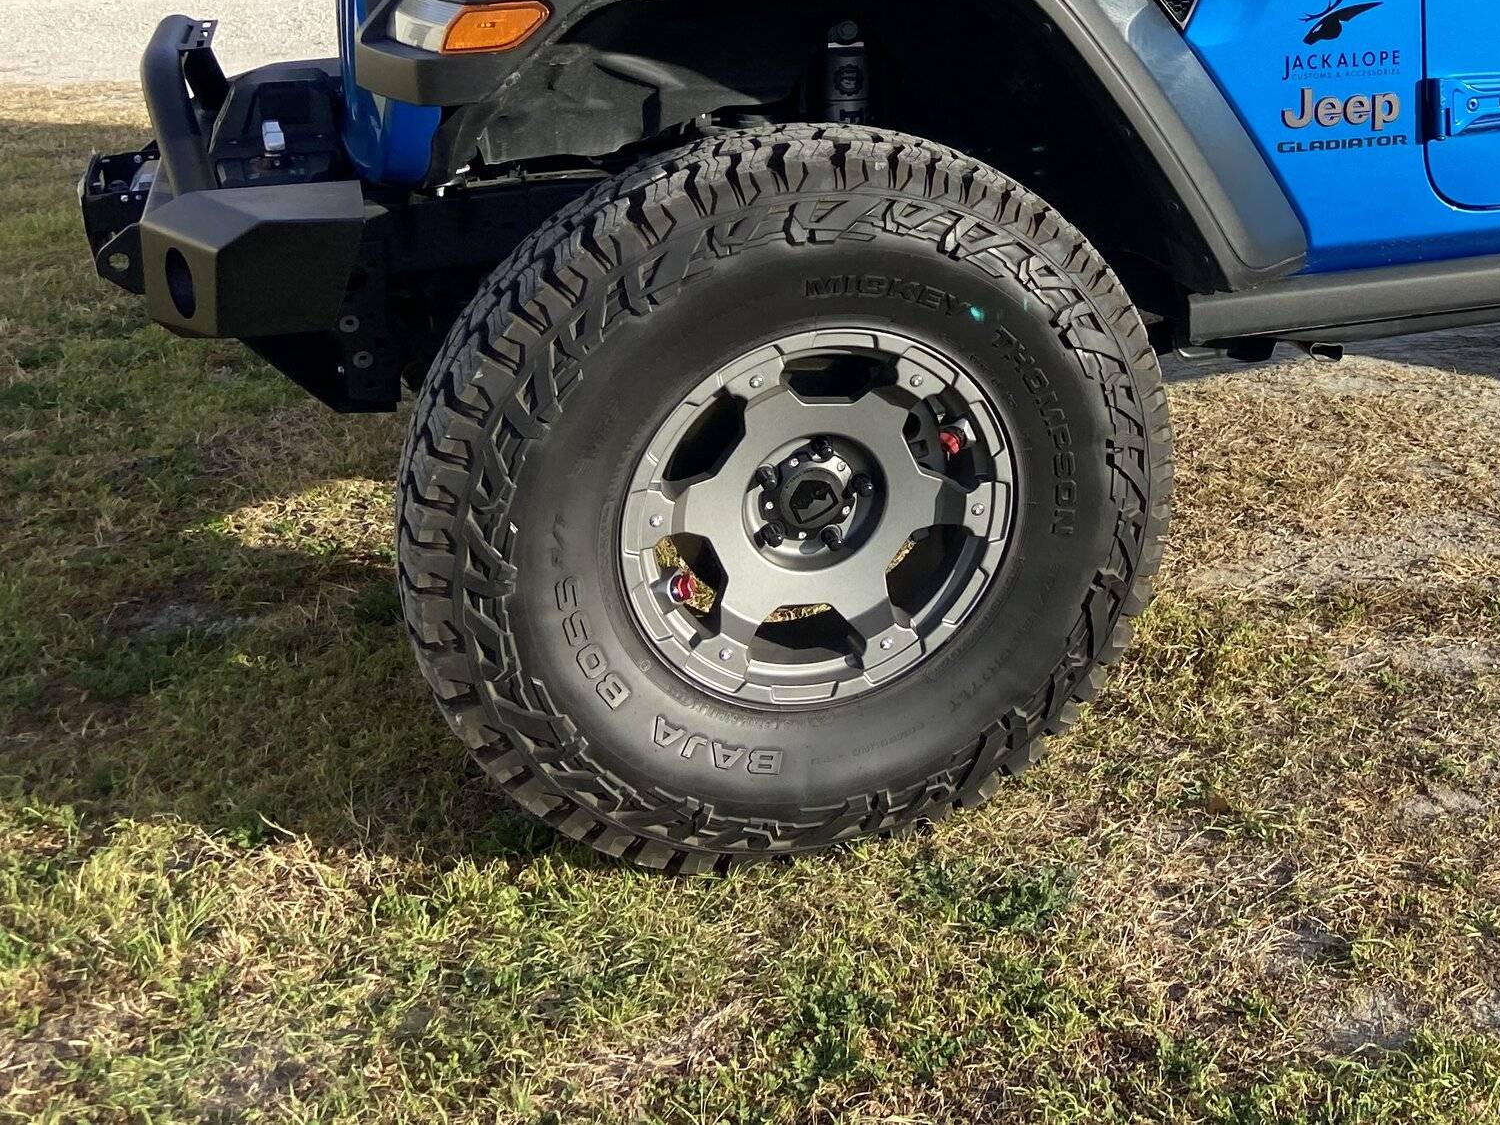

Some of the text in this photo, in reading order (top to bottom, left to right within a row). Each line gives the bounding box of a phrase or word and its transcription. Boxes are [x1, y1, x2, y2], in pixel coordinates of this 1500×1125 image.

[1281, 49, 1401, 81] JACKALOPE
[1281, 86, 1401, 132] Jeep
[1277, 134, 1409, 154] GLADIATOR
[992, 323, 1077, 536] THOMPSON
[554, 575, 632, 711] BOSS
[652, 714, 785, 776] BAJA
